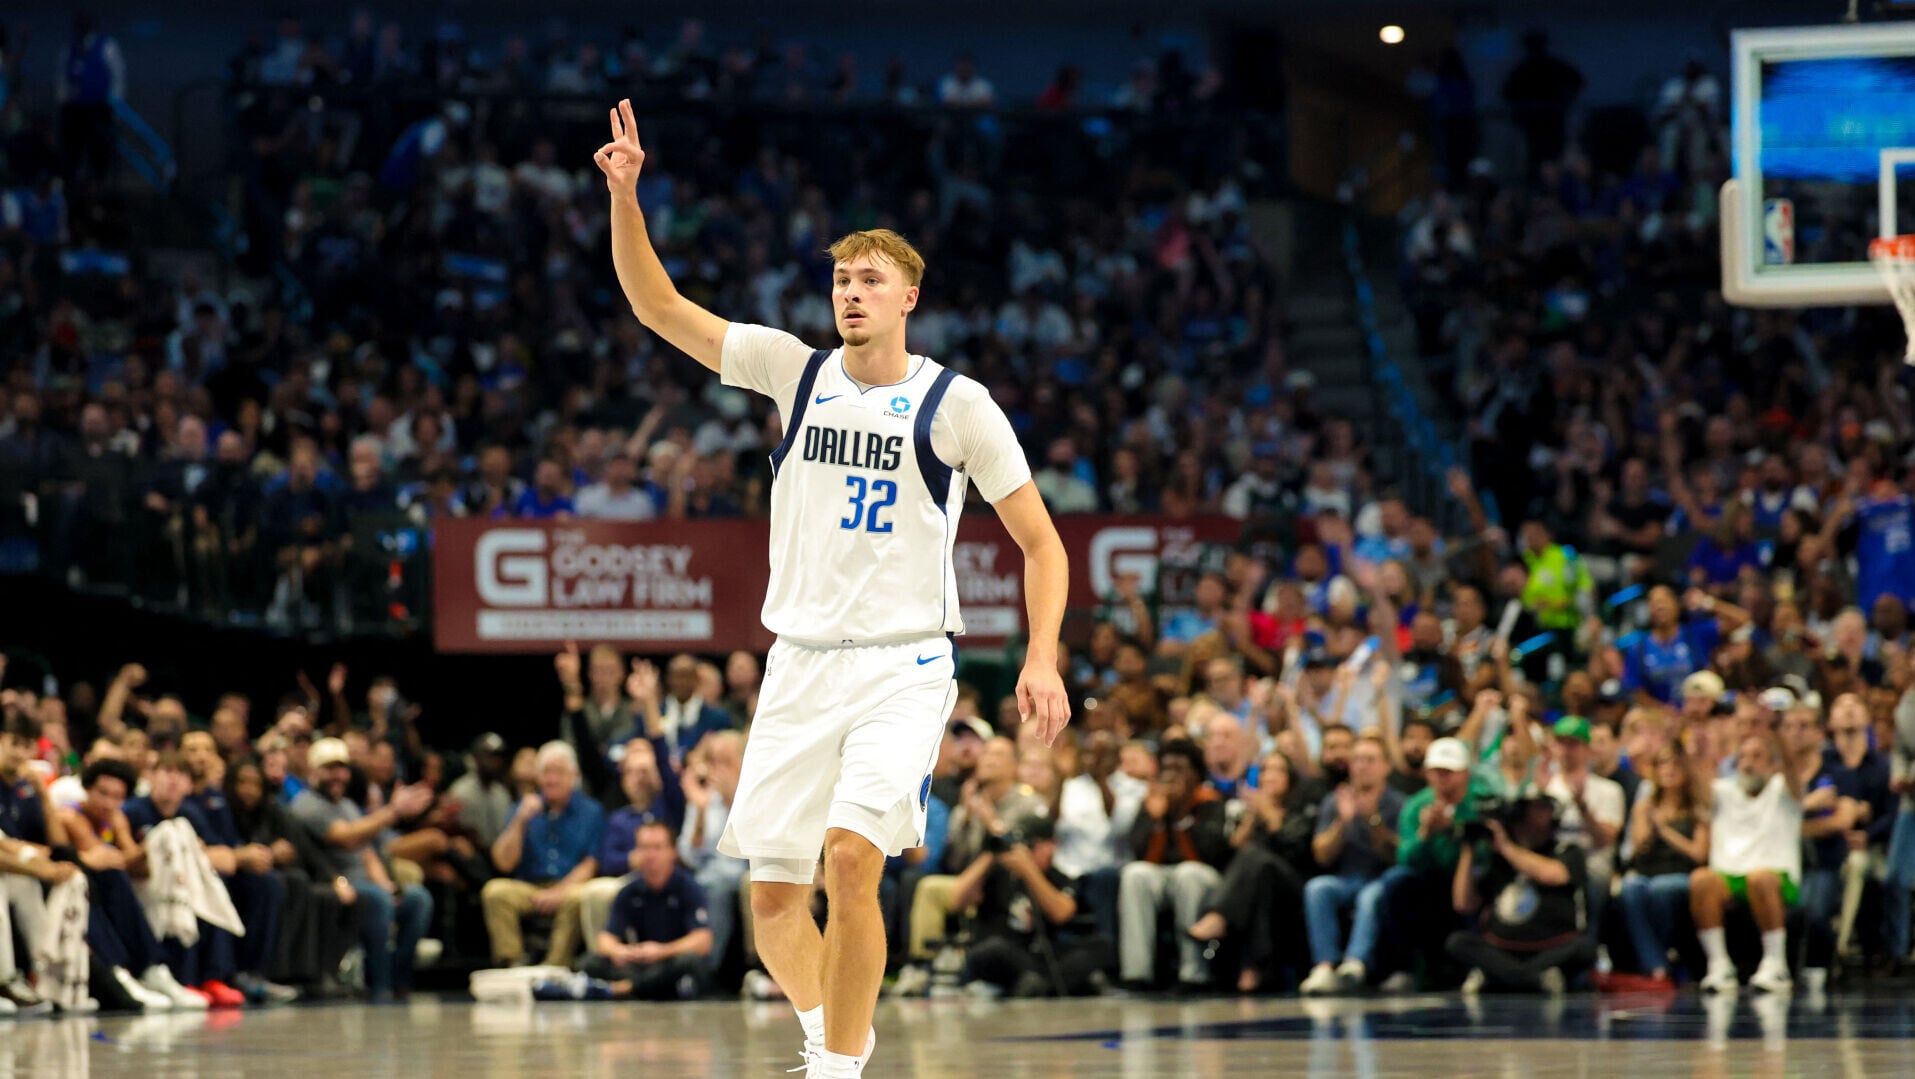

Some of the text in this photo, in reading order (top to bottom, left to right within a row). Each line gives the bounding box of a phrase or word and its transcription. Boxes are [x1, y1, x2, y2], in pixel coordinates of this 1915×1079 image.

[883, 410, 910, 420] CHASE
[803, 425, 904, 471] DALLAS
[840, 475, 898, 534] 32
[475, 528, 548, 607] G
[552, 544, 694, 577] GODSEY
[552, 575, 713, 607] LAW FIRM
